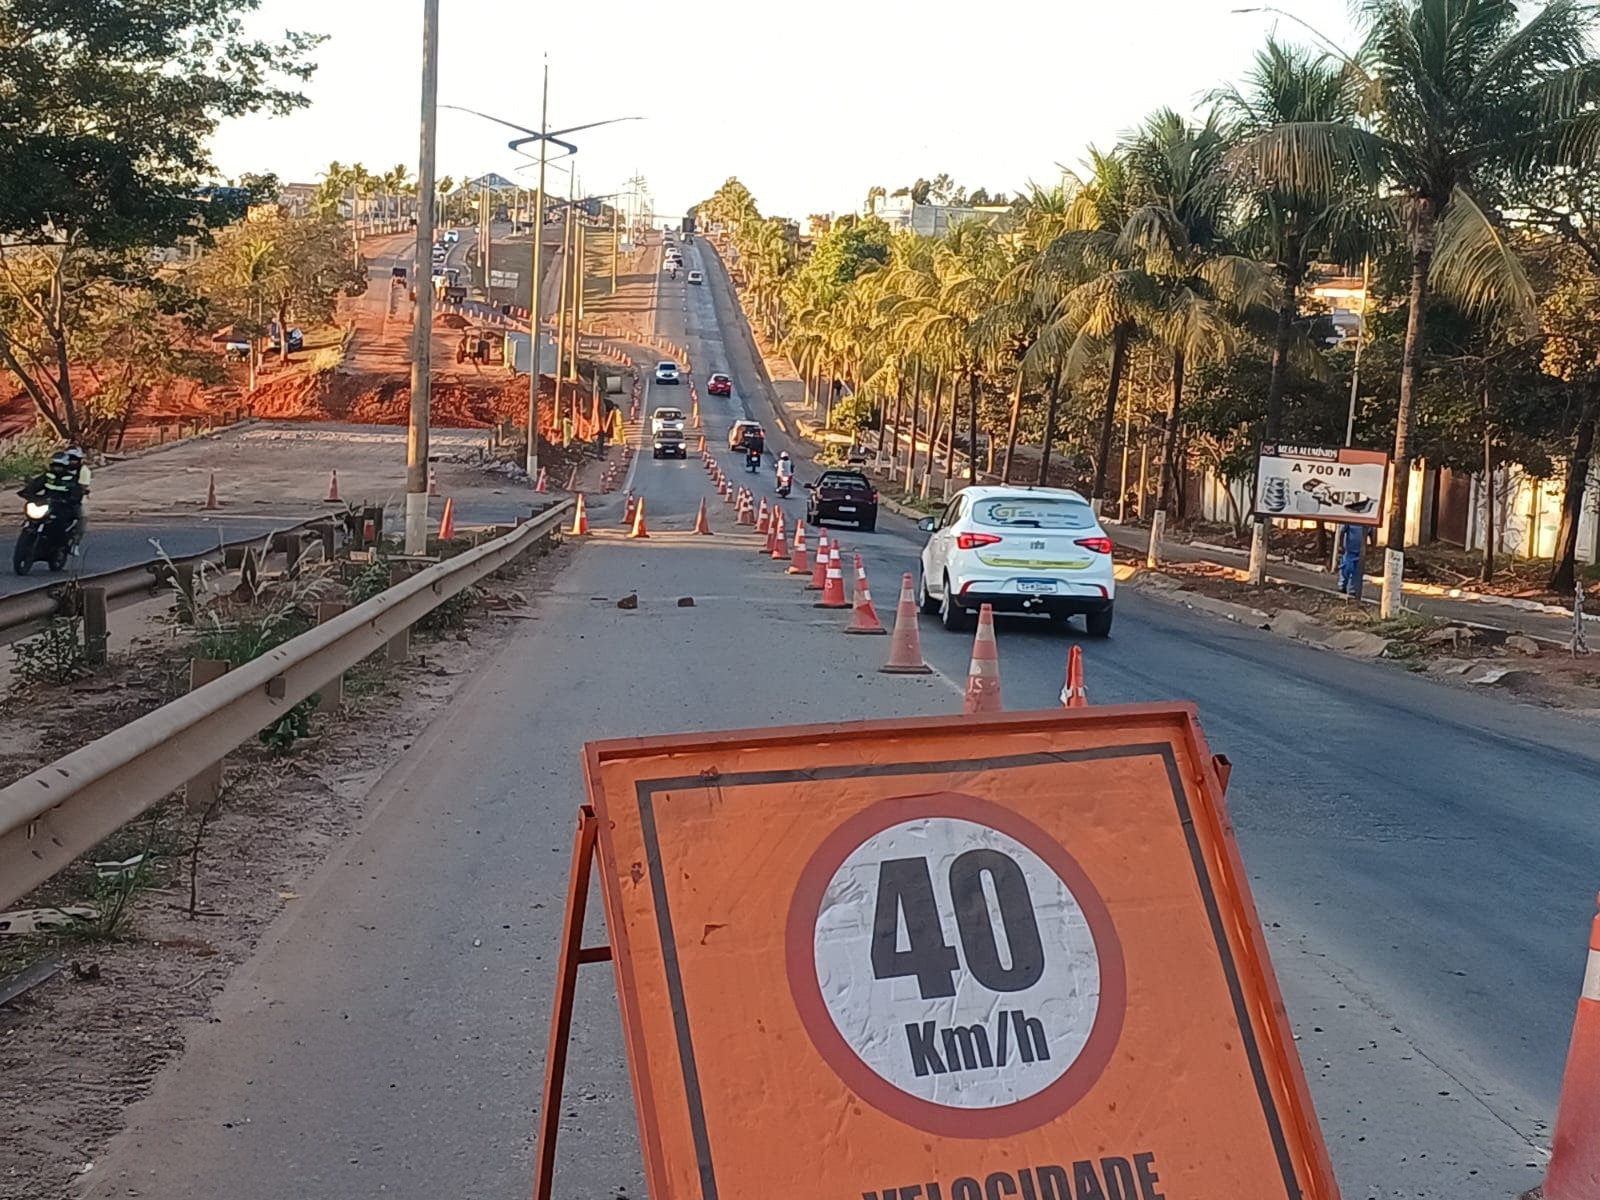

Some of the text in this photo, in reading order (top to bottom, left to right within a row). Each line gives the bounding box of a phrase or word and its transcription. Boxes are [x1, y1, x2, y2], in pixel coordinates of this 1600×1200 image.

[1278, 444, 1298, 454] MEGA
[1292, 463, 1351, 477] A 700 M
[871, 848, 1045, 1000] 40
[904, 1009, 1050, 1077] Km/h
[862, 1151, 1165, 1200] CIDADE
